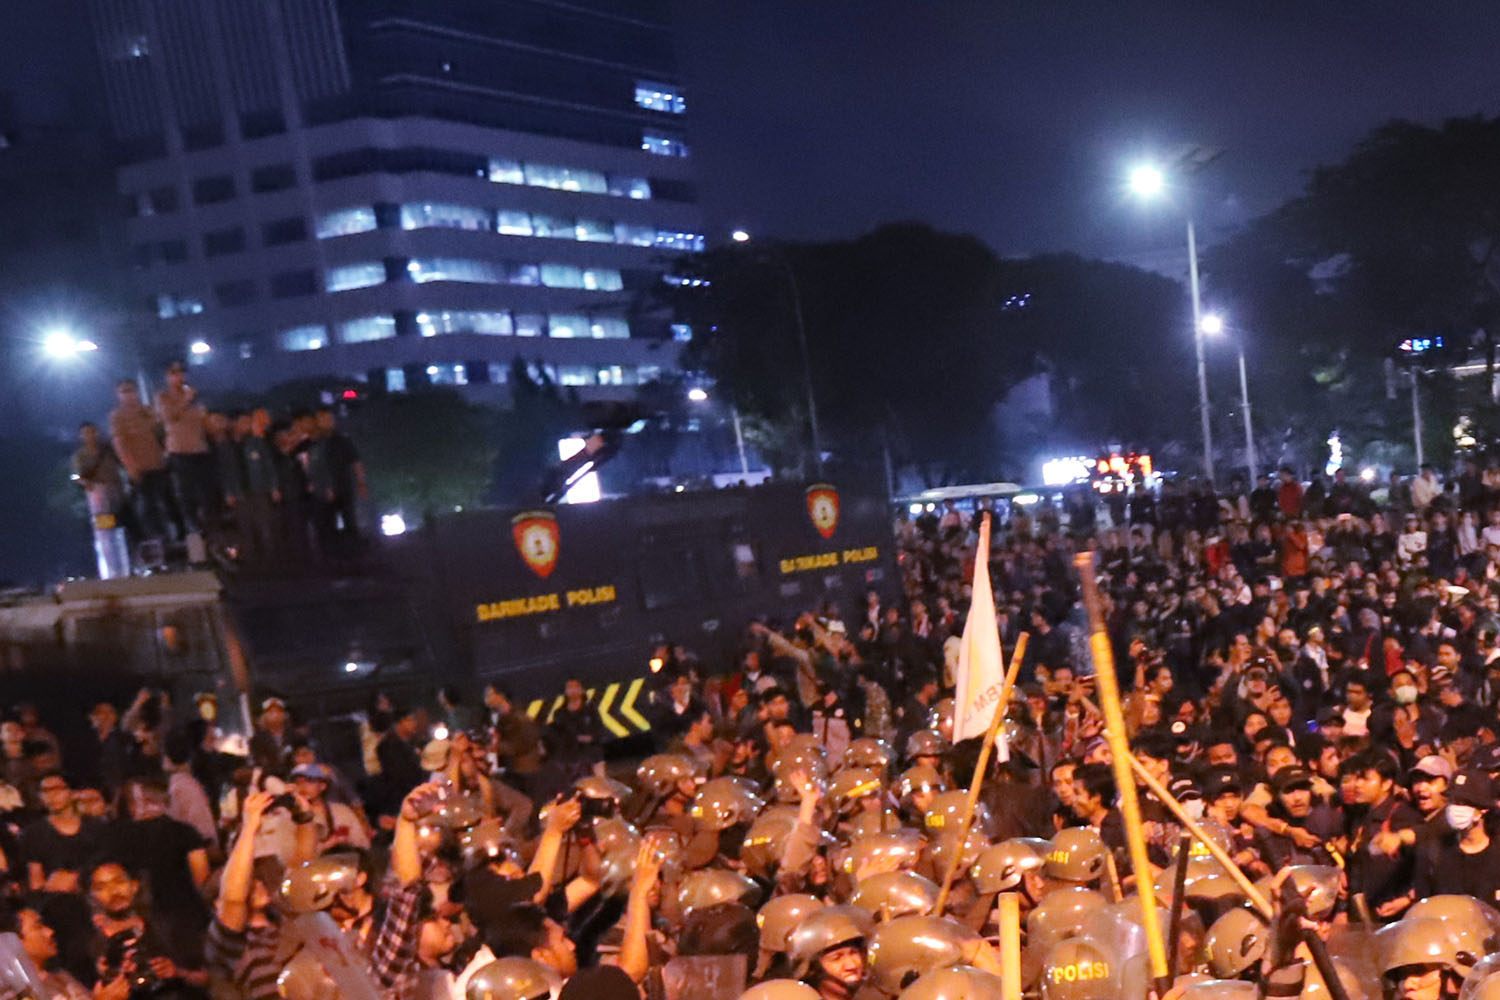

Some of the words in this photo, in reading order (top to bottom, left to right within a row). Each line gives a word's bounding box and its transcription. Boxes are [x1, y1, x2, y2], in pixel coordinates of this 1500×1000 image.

[477, 593, 560, 620] BARIKADE
[566, 586, 615, 605] POLISI
[1054, 961, 1109, 984] POLISI
